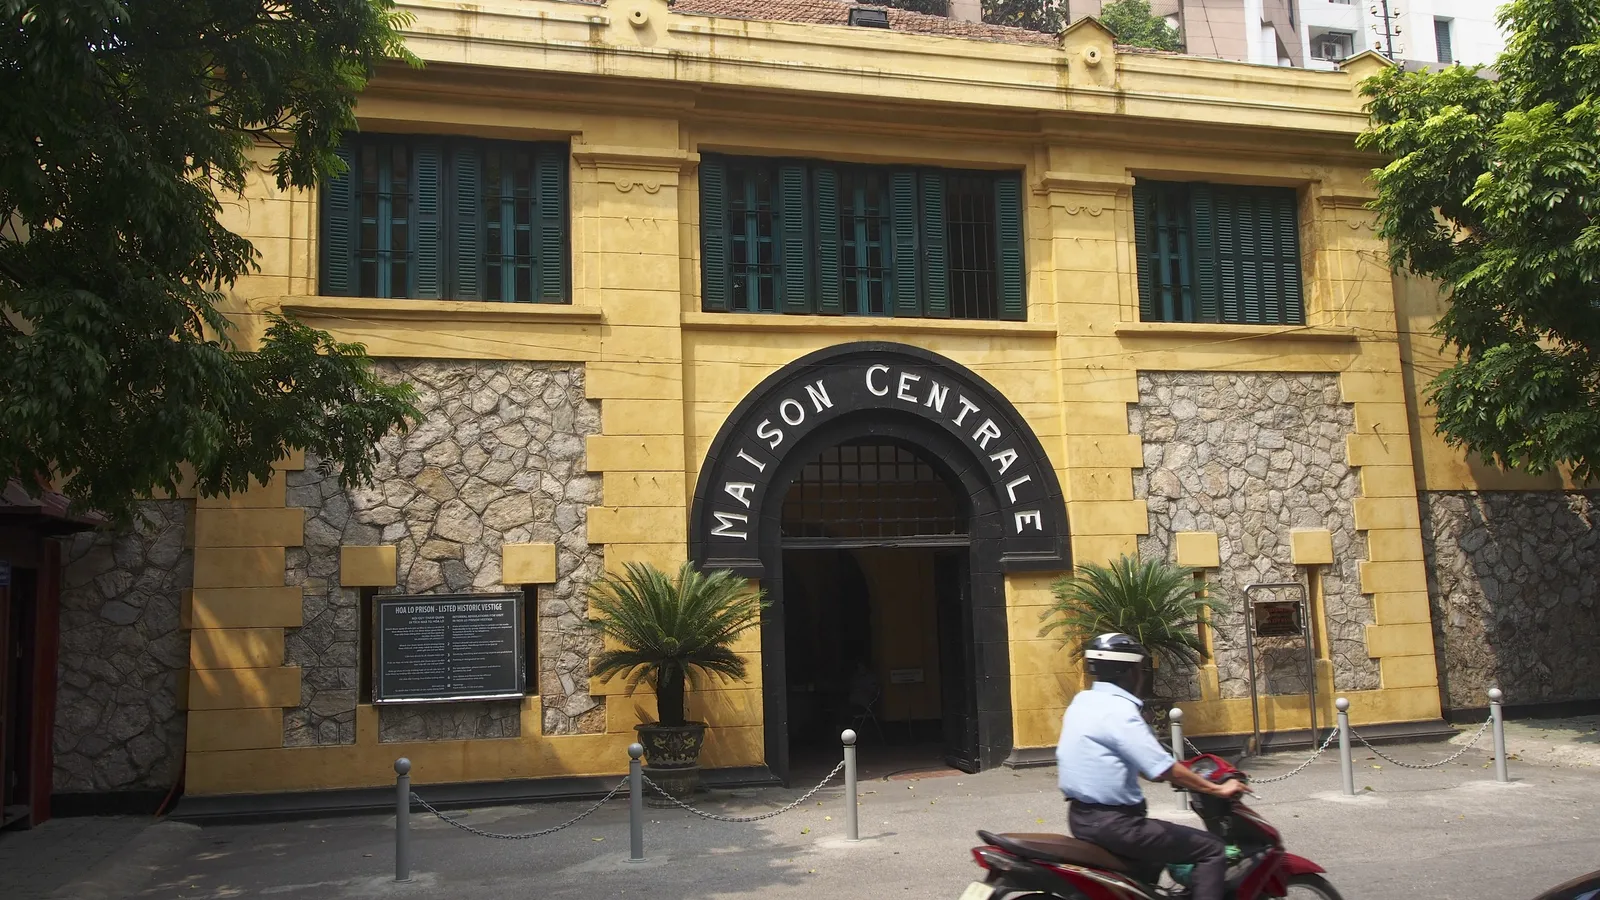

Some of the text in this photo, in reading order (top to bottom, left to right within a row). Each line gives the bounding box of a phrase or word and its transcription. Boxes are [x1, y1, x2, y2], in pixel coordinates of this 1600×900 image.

[710, 363, 1043, 541] MAISON CENTRALE
[395, 606, 407, 614] HOA
[407, 606, 415, 614] LO
[415, 605, 435, 613] PRISON
[438, 604, 457, 613] LISTED
[457, 604, 481, 612] HISTORIC
[481, 603, 502, 611] VESTIGE
